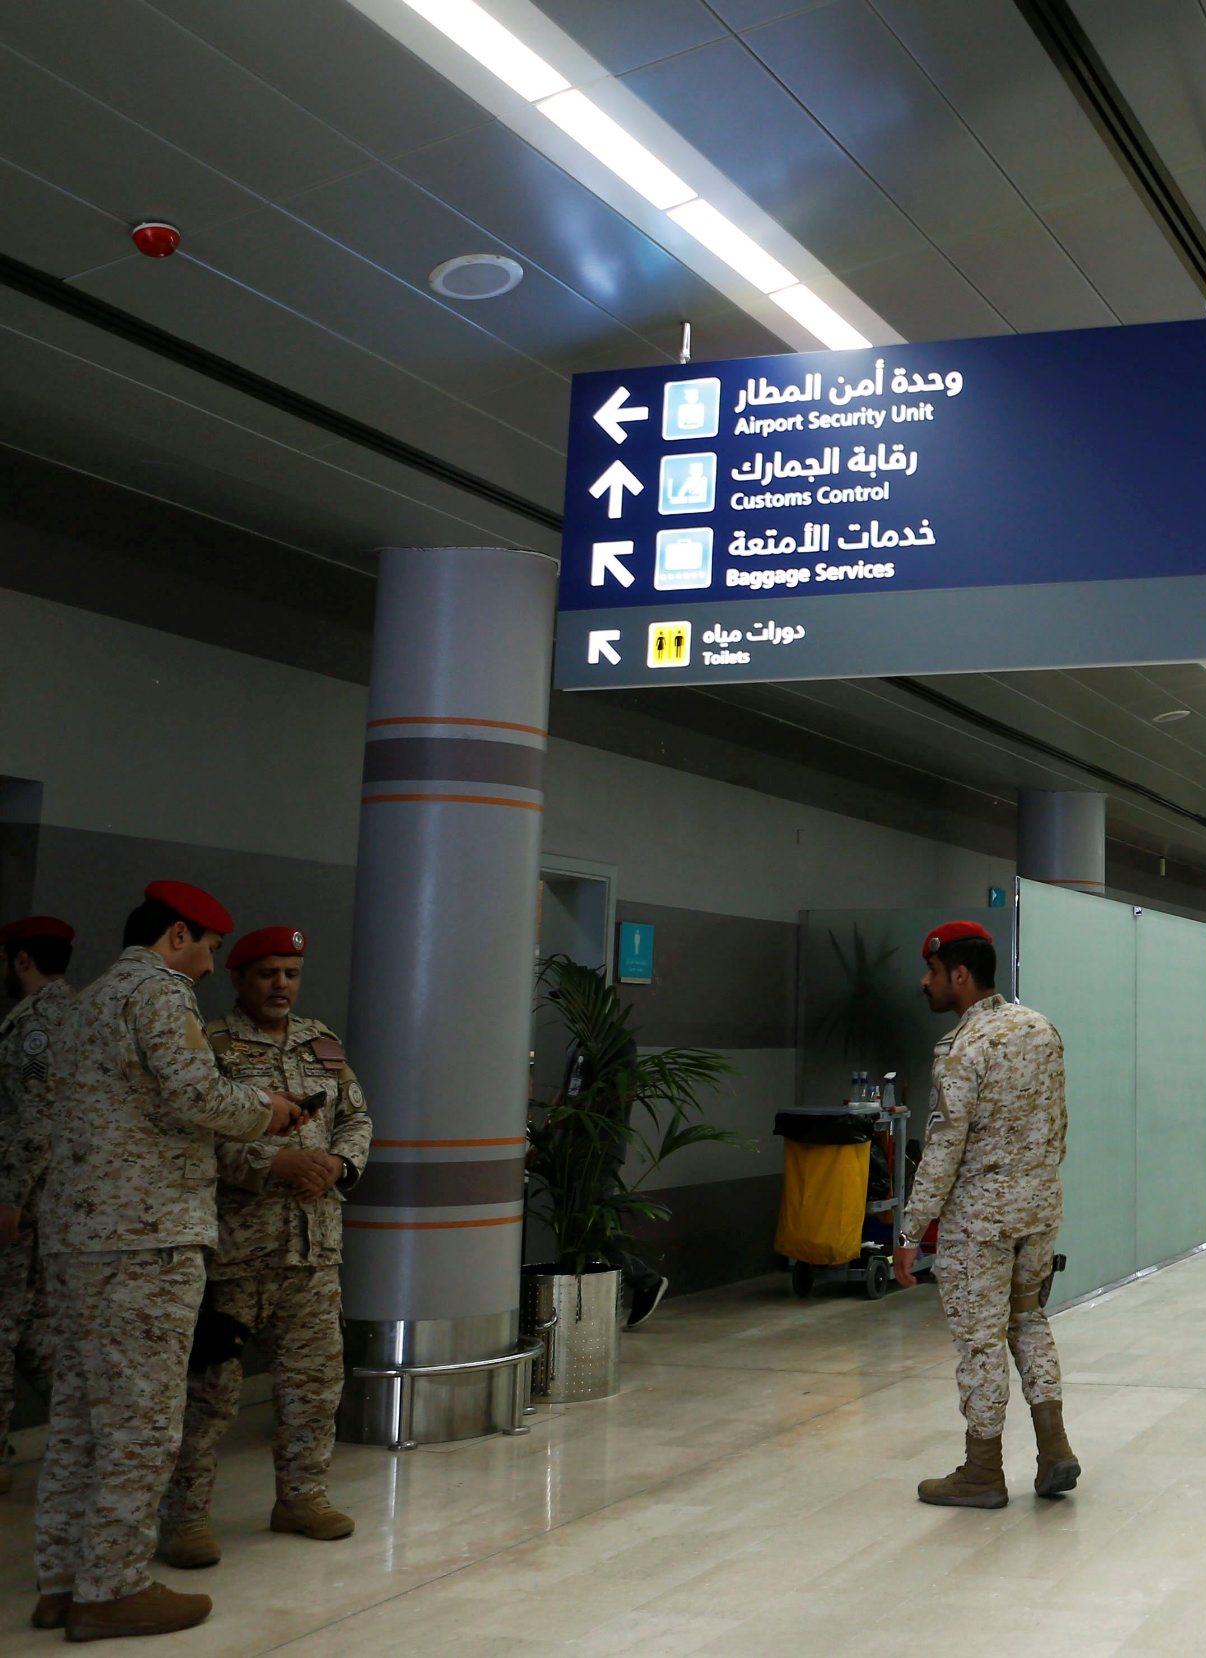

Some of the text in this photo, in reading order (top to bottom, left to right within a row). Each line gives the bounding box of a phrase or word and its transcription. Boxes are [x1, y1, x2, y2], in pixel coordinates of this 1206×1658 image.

[735, 360, 962, 413] وحدة أمن المطار
[734, 402, 934, 437] Airport Security Unit
[731, 443, 917, 486] رقابة الجمارك
[731, 481, 889, 510] Customs Control
[728, 519, 935, 556] خدمات الأمتعة
[726, 560, 894, 589] Baggage Services
[703, 621, 805, 647] دورات مياه
[702, 650, 750, 665] Toilets
